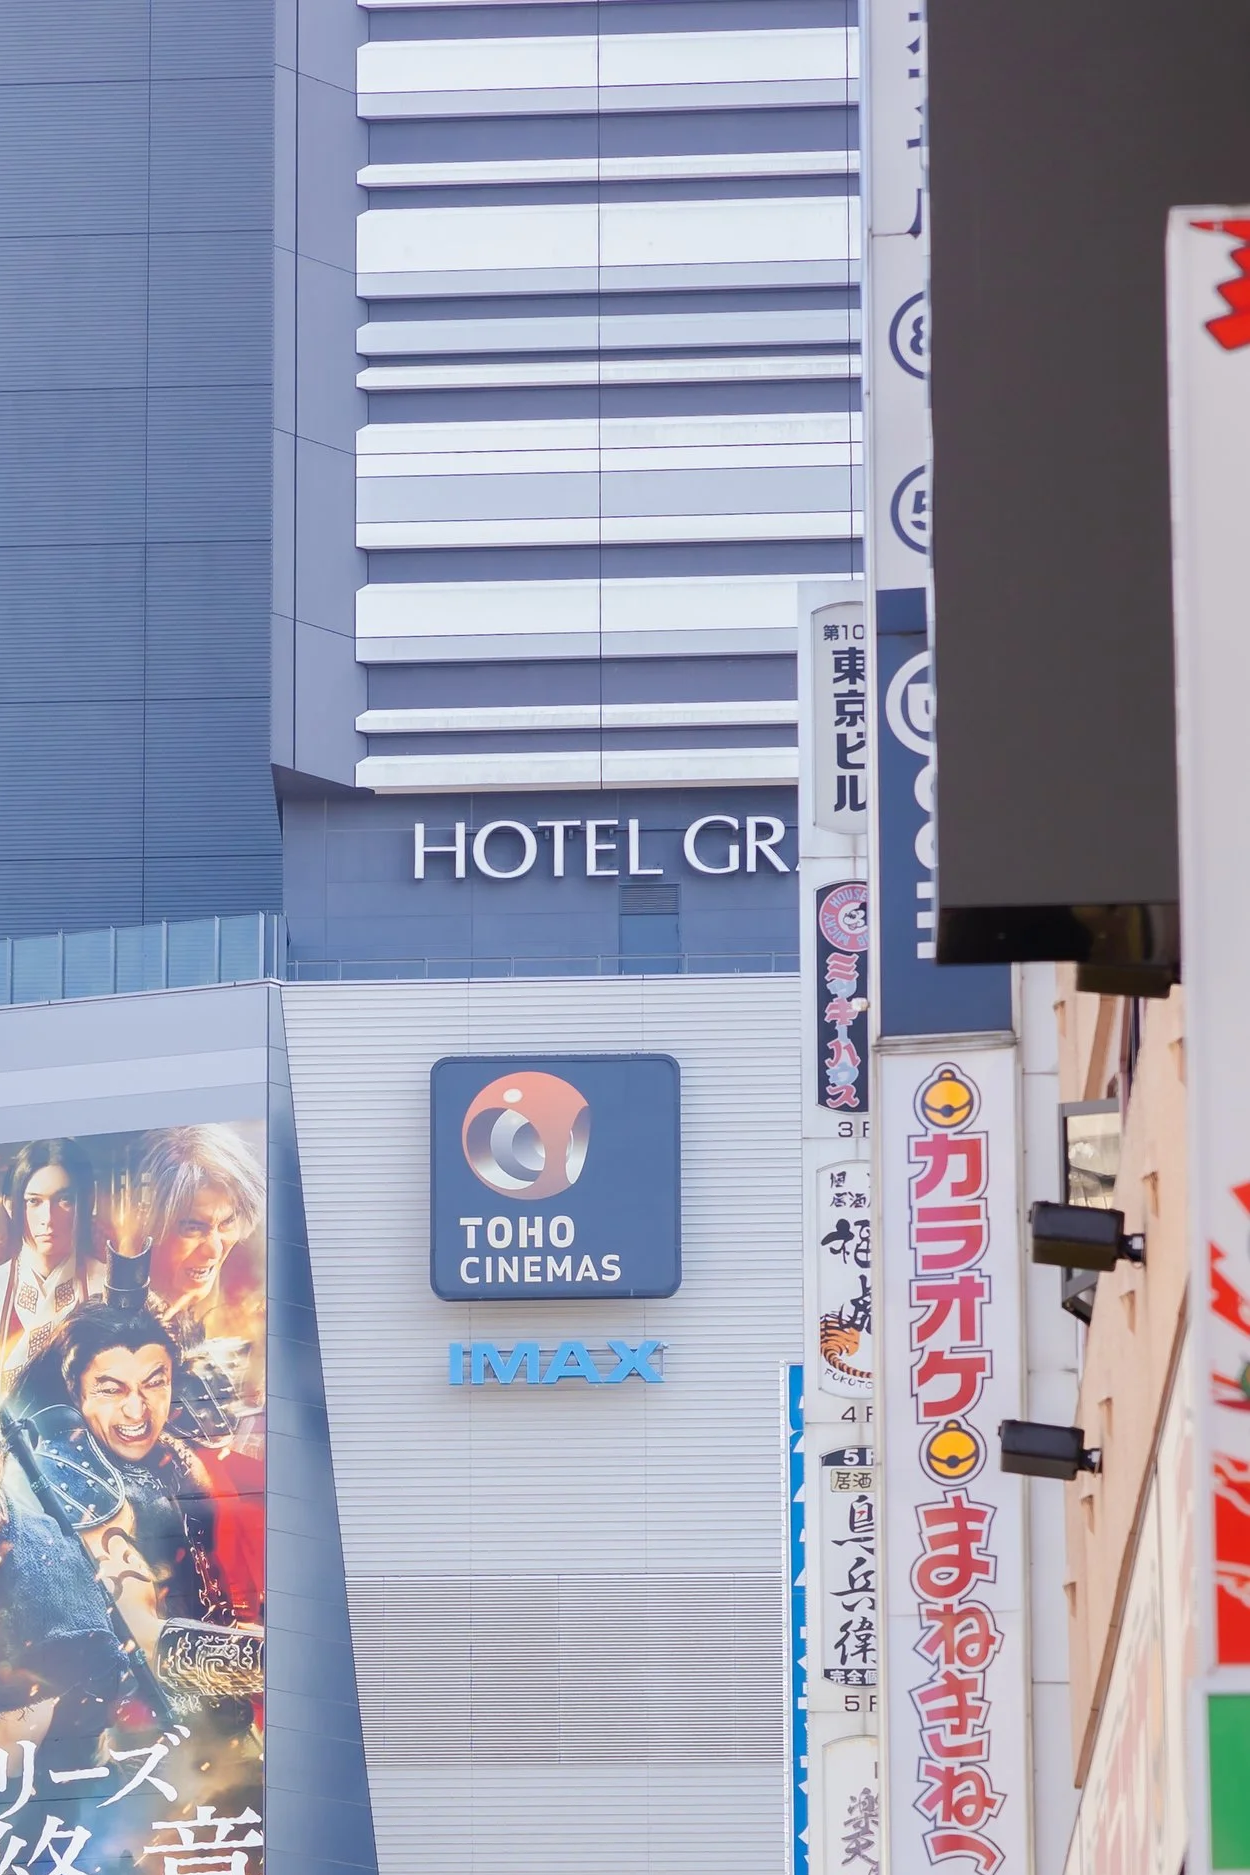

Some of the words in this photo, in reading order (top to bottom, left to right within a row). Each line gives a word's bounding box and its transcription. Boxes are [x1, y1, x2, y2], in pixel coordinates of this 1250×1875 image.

[413, 817, 665, 880] HOTEL
[683, 814, 799, 875] GR
[824, 952, 860, 1109] ミッキーハウス
[459, 1215, 575, 1251] TOHO
[459, 1253, 623, 1284] CINEMAS
[913, 1132, 987, 1419] カラオケ
[450, 1340, 665, 1385] IMAX
